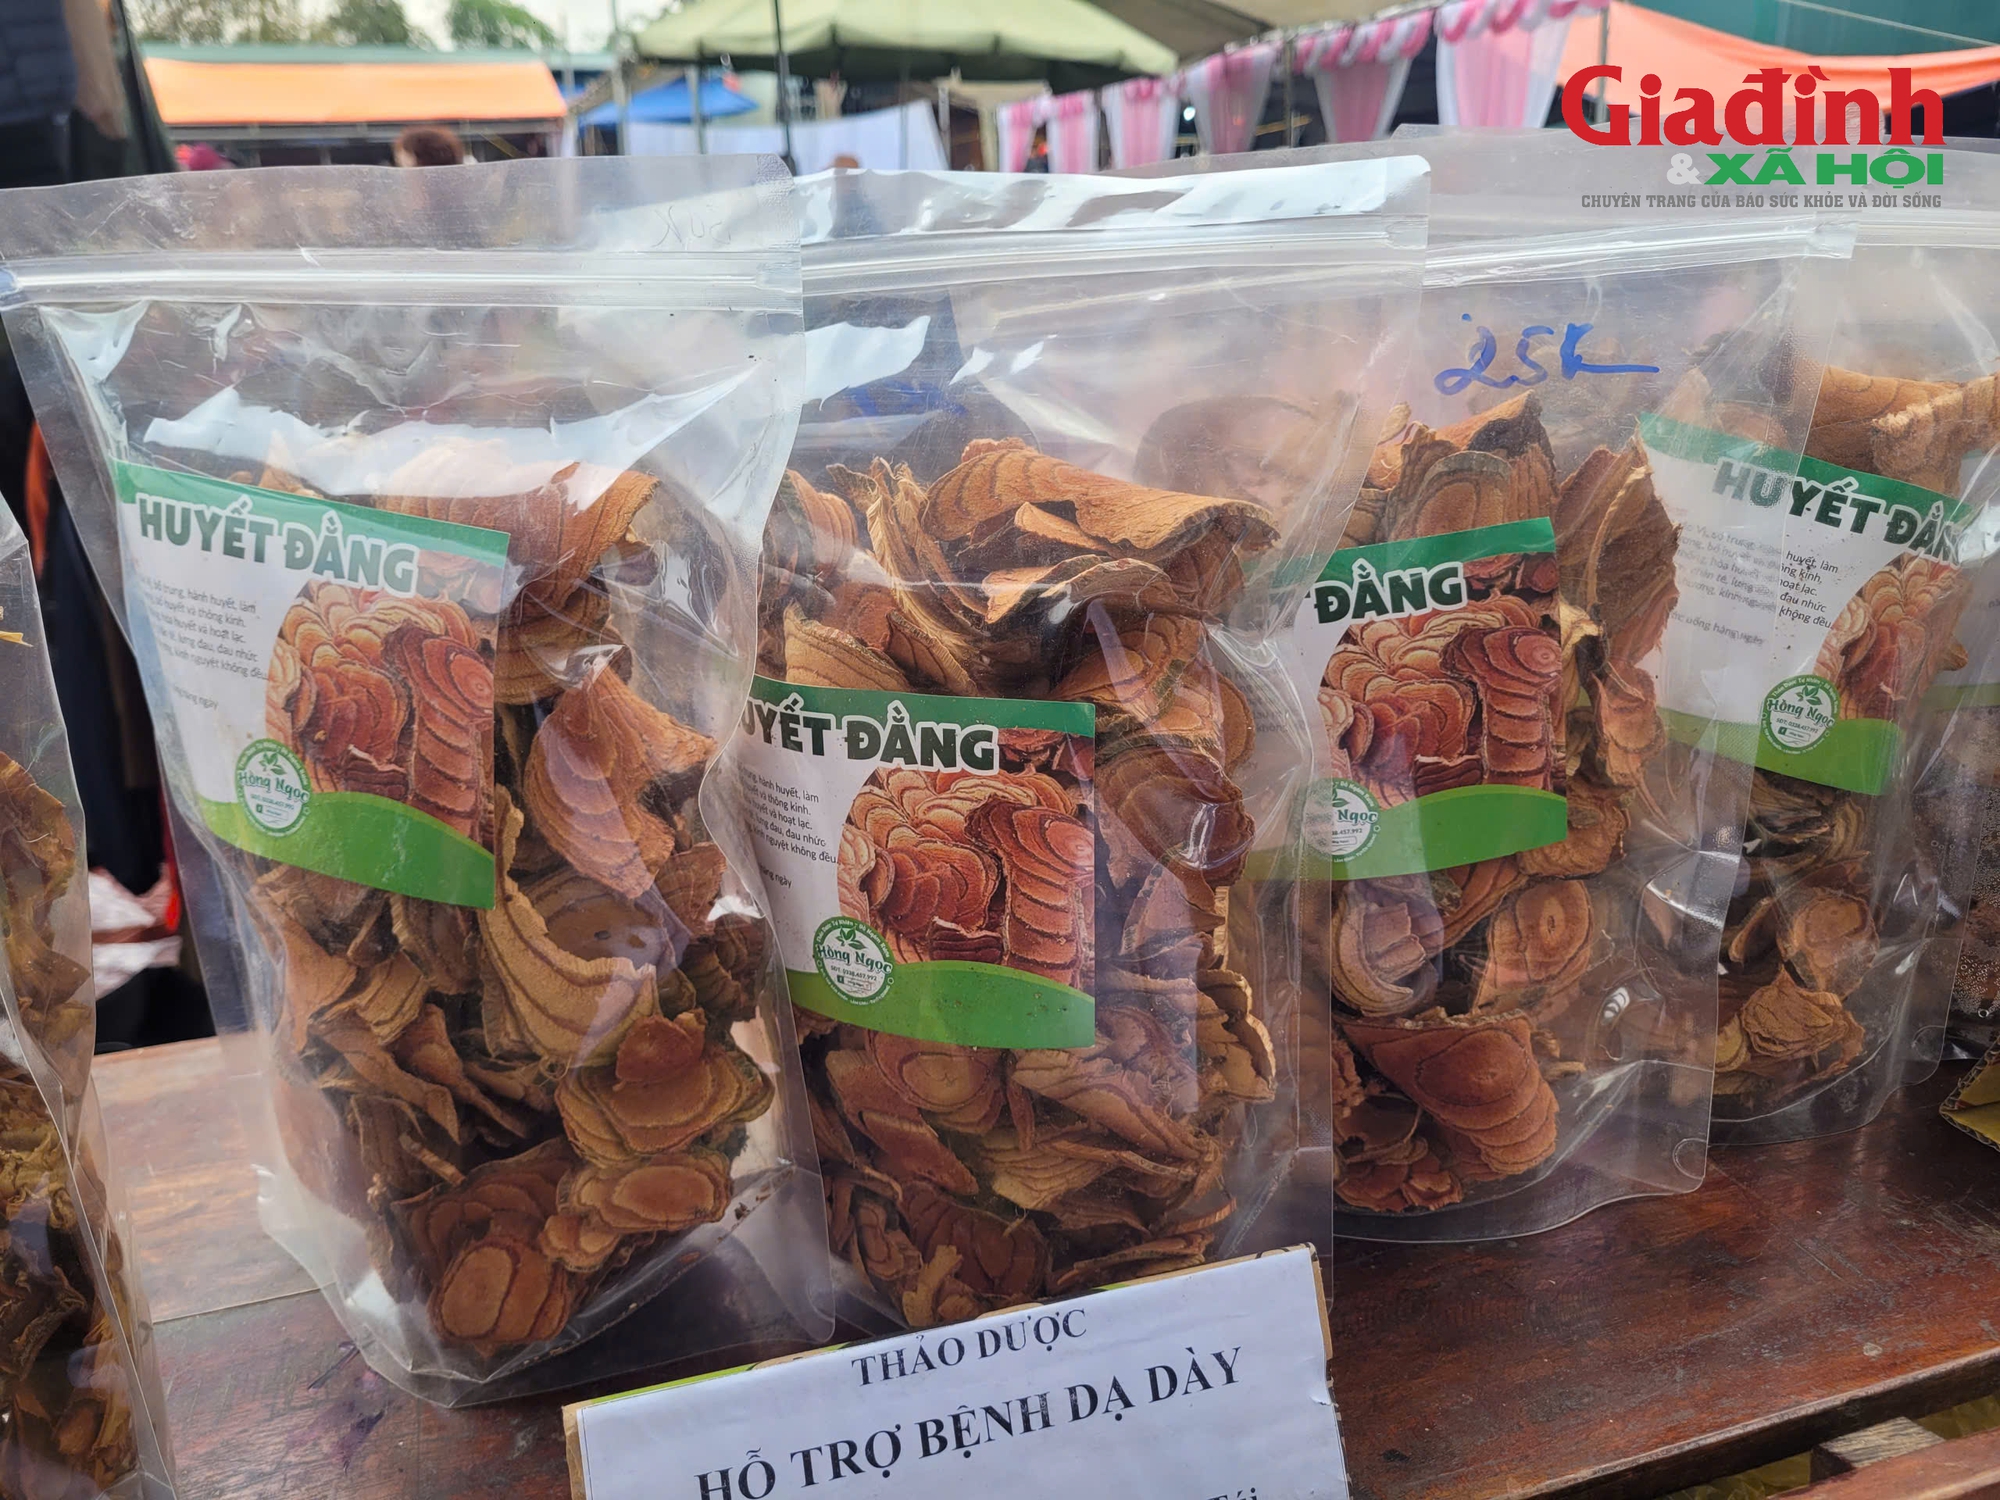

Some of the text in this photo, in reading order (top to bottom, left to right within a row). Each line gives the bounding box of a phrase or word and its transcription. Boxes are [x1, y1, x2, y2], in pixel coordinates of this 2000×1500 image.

[1712, 460, 1881, 534] HUYẾT
[139, 498, 414, 594] HUYẾT ĐẰNG
[1786, 550, 1817, 568] huyết,
[1820, 560, 1839, 574] làm
[1314, 563, 1463, 624] ĐẰNG
[1780, 592, 1799, 605] đau
[1801, 599, 1827, 613] nhức
[1800, 583, 1818, 598] lạc.
[1779, 605, 1810, 624] không
[740, 697, 995, 771] UYẾT ĐẰNG
[776, 782, 801, 800] huyết,
[803, 790, 819, 803] làm
[778, 812, 796, 826] hoạt
[798, 817, 813, 831] lạc.
[1337, 809, 1379, 826] Ngọc
[770, 821, 784, 837] đau,
[786, 828, 801, 841] đau
[803, 834, 827, 847] nhức
[791, 842, 817, 861] không
[855, 951, 893, 975] Ngọc
[852, 1308, 1088, 1388] THẢO DƯỢC
[696, 1345, 1242, 1500] HỖ TRỢ BỆNH DẠ DÀY
